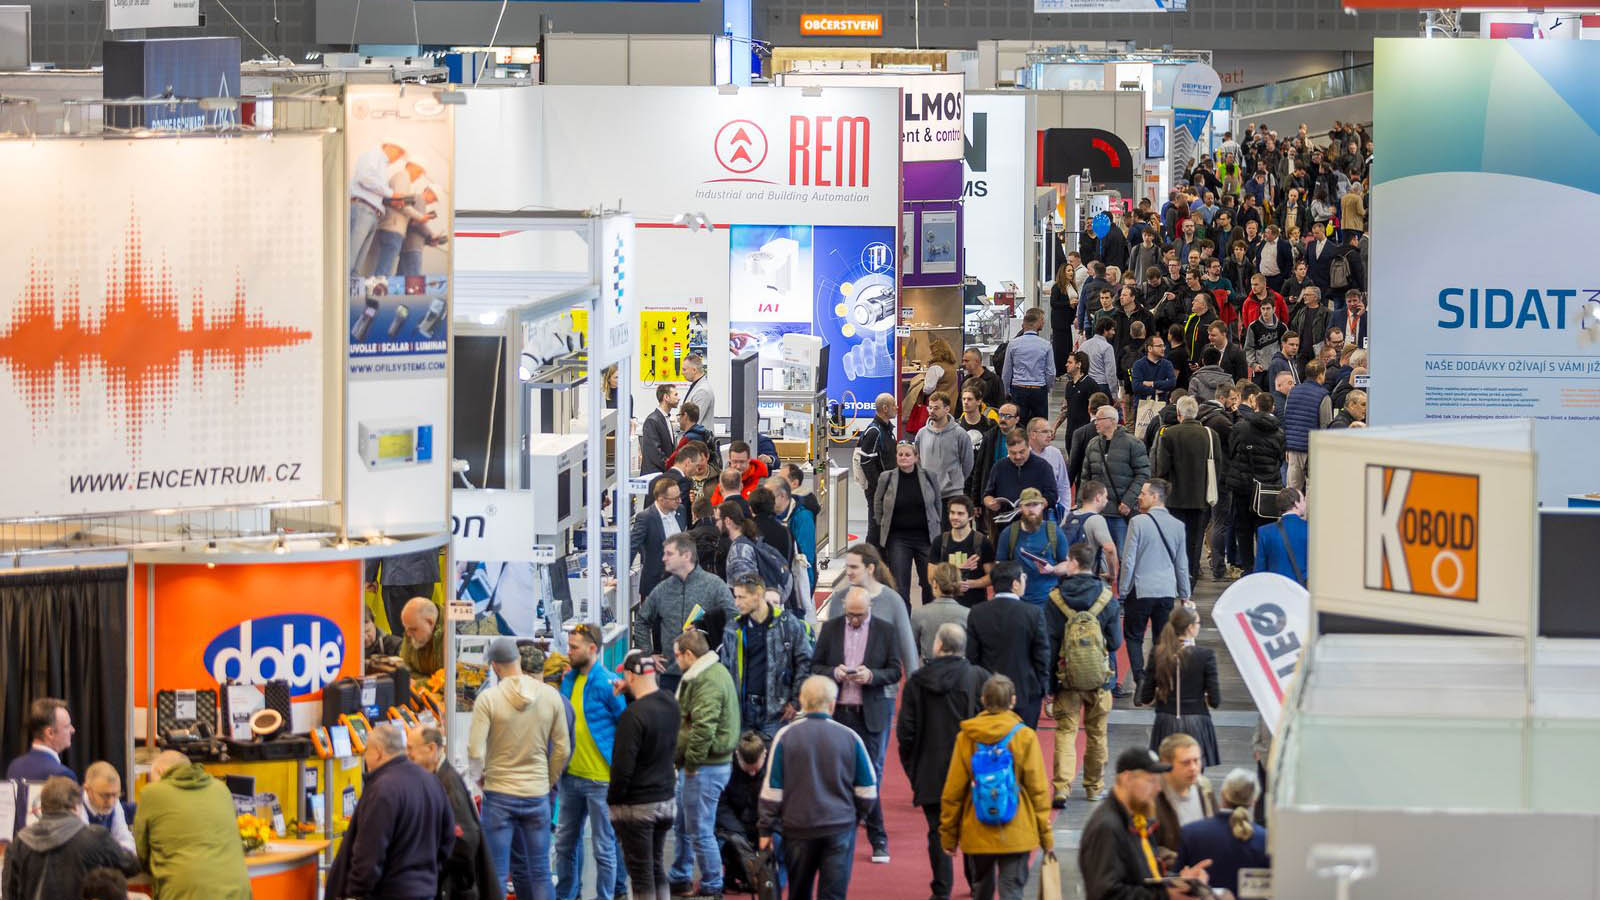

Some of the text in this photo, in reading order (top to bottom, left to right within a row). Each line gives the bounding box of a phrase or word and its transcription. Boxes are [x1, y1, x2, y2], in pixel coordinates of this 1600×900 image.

[804, 18, 878, 30] OBČERSTVENÍ
[924, 128, 932, 142] &
[789, 115, 870, 187] REM
[695, 190, 870, 203] Industrial and Building Automation
[758, 304, 779, 312] IAI
[1438, 288, 1576, 329] SIDAT
[382, 342, 409, 352] SCALAR
[416, 341, 447, 351] LUMINAR
[1425, 359, 1453, 371] NAŠE
[1456, 359, 1505, 371] DODÁVKY
[1508, 359, 1546, 373] OŽÍVAJÍ
[1549, 361, 1555, 371] S
[1558, 360, 1584, 372] VÁMI
[70, 463, 302, 494] WWW.ENCENTRUM.CZ
[213, 620, 341, 694] doble
